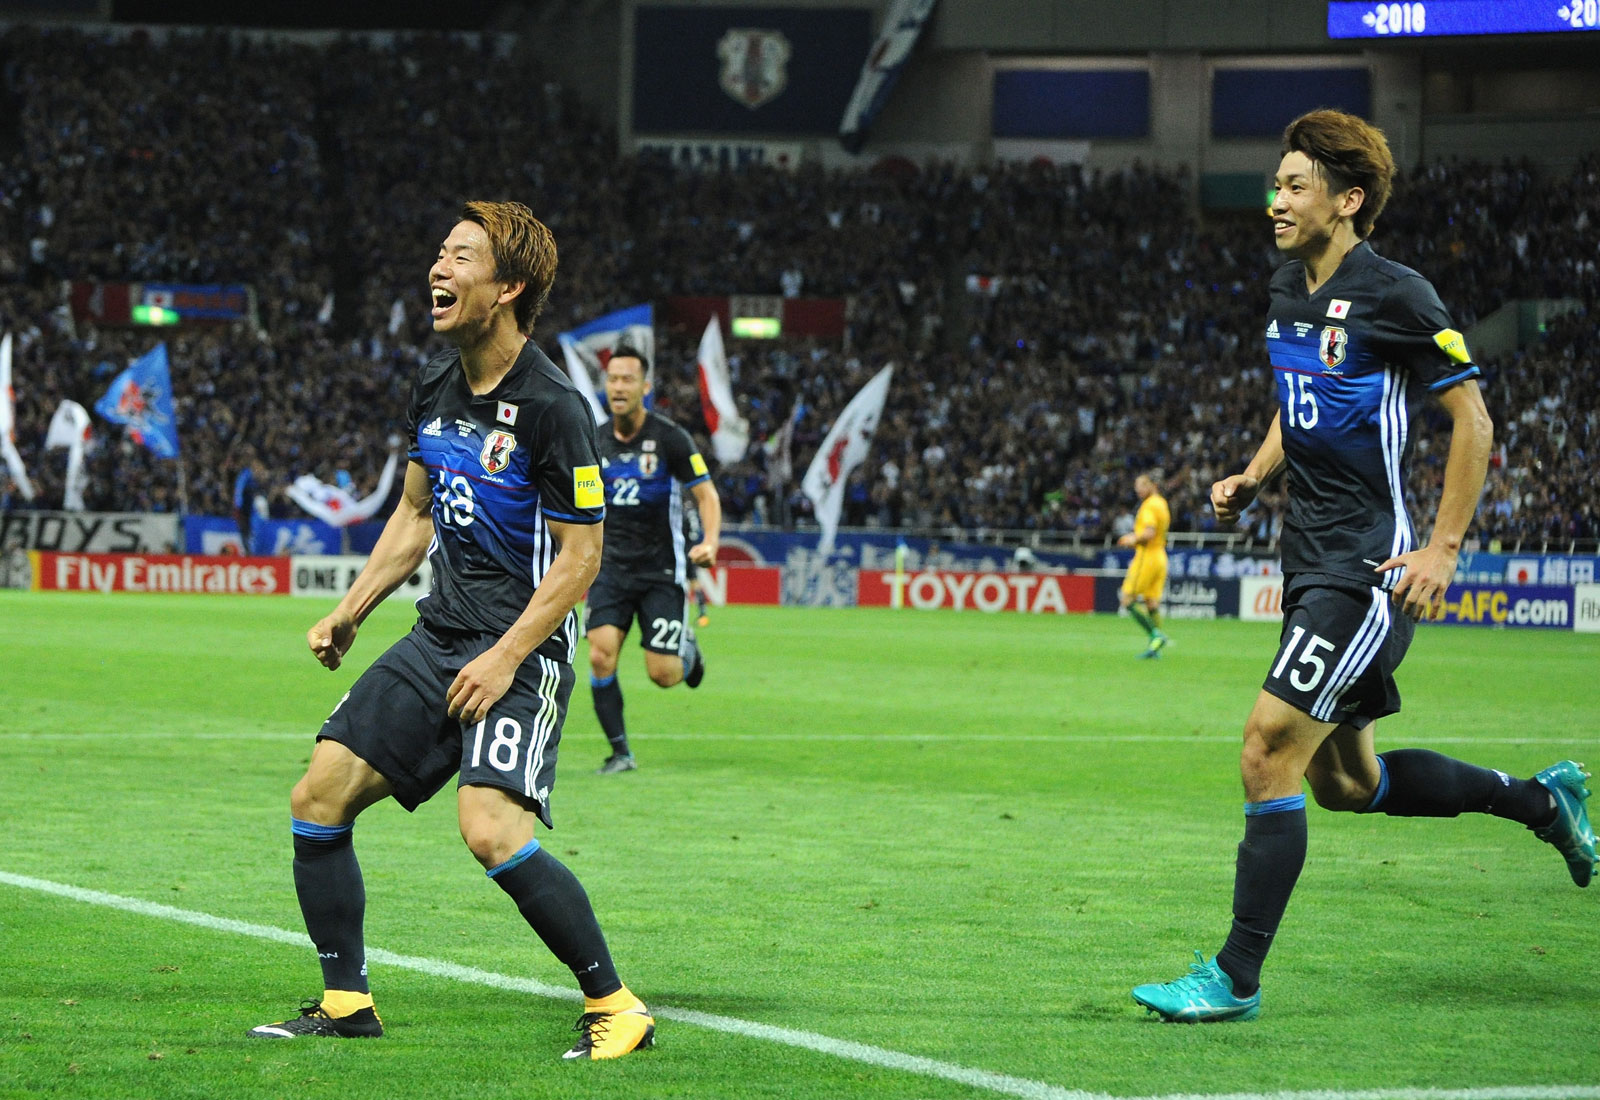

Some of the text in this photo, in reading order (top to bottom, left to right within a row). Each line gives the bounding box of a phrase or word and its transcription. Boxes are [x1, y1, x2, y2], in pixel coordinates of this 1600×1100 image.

[1375, 2, 1425, 34] 2018
[1284, 372, 1319, 429] 15
[438, 470, 475, 526] 18
[577, 480, 596, 489] FIFA
[612, 477, 640, 506] 22
[56, 555, 277, 594] Fly Emirates
[297, 567, 337, 590] ONE
[881, 573, 1068, 613] TOYOTA
[650, 617, 682, 650] 22
[1271, 626, 1336, 692] 15
[470, 716, 522, 772] 18
